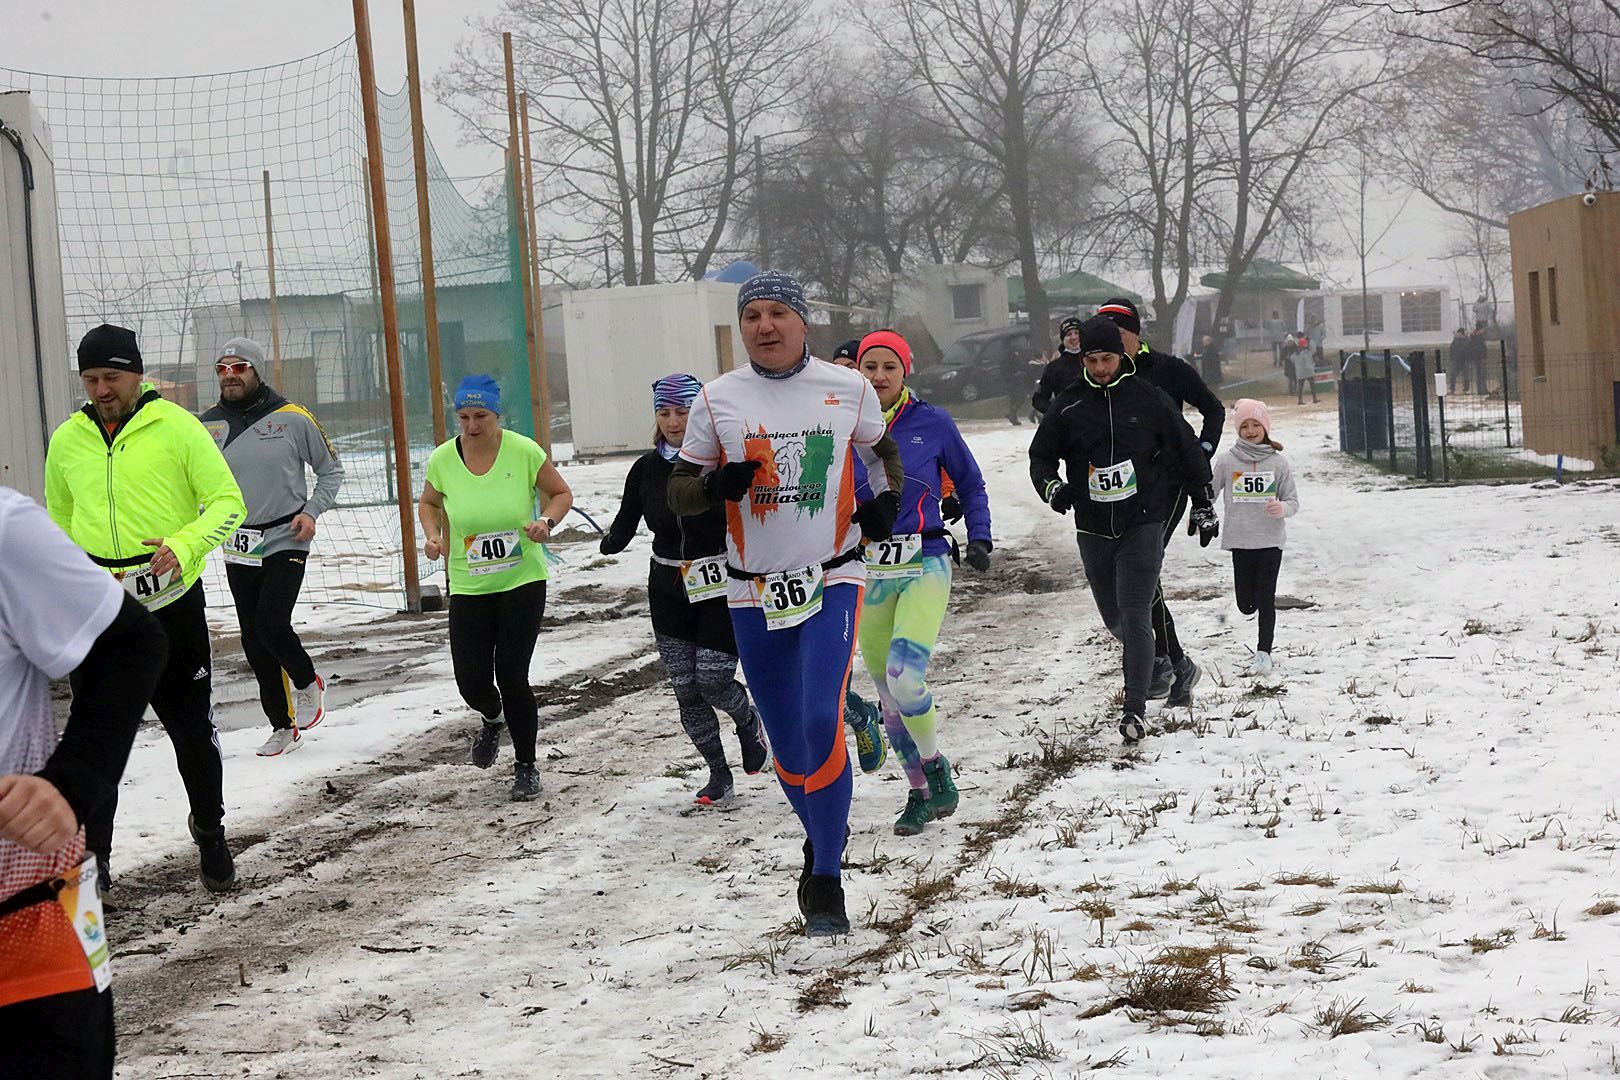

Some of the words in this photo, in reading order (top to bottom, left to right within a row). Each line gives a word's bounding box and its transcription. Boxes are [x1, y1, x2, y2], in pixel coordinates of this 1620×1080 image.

[745, 431, 798, 440] Biegająca
[753, 482, 821, 493] Miedziowego
[1098, 470, 1123, 491] 54
[1244, 477, 1264, 493] 56
[754, 490, 821, 505] Miasta
[234, 533, 249, 553] 43
[481, 538, 506, 560] 40
[879, 543, 902, 565] 27
[698, 562, 722, 585] 13
[135, 573, 161, 597] 47
[770, 578, 807, 611] 36
